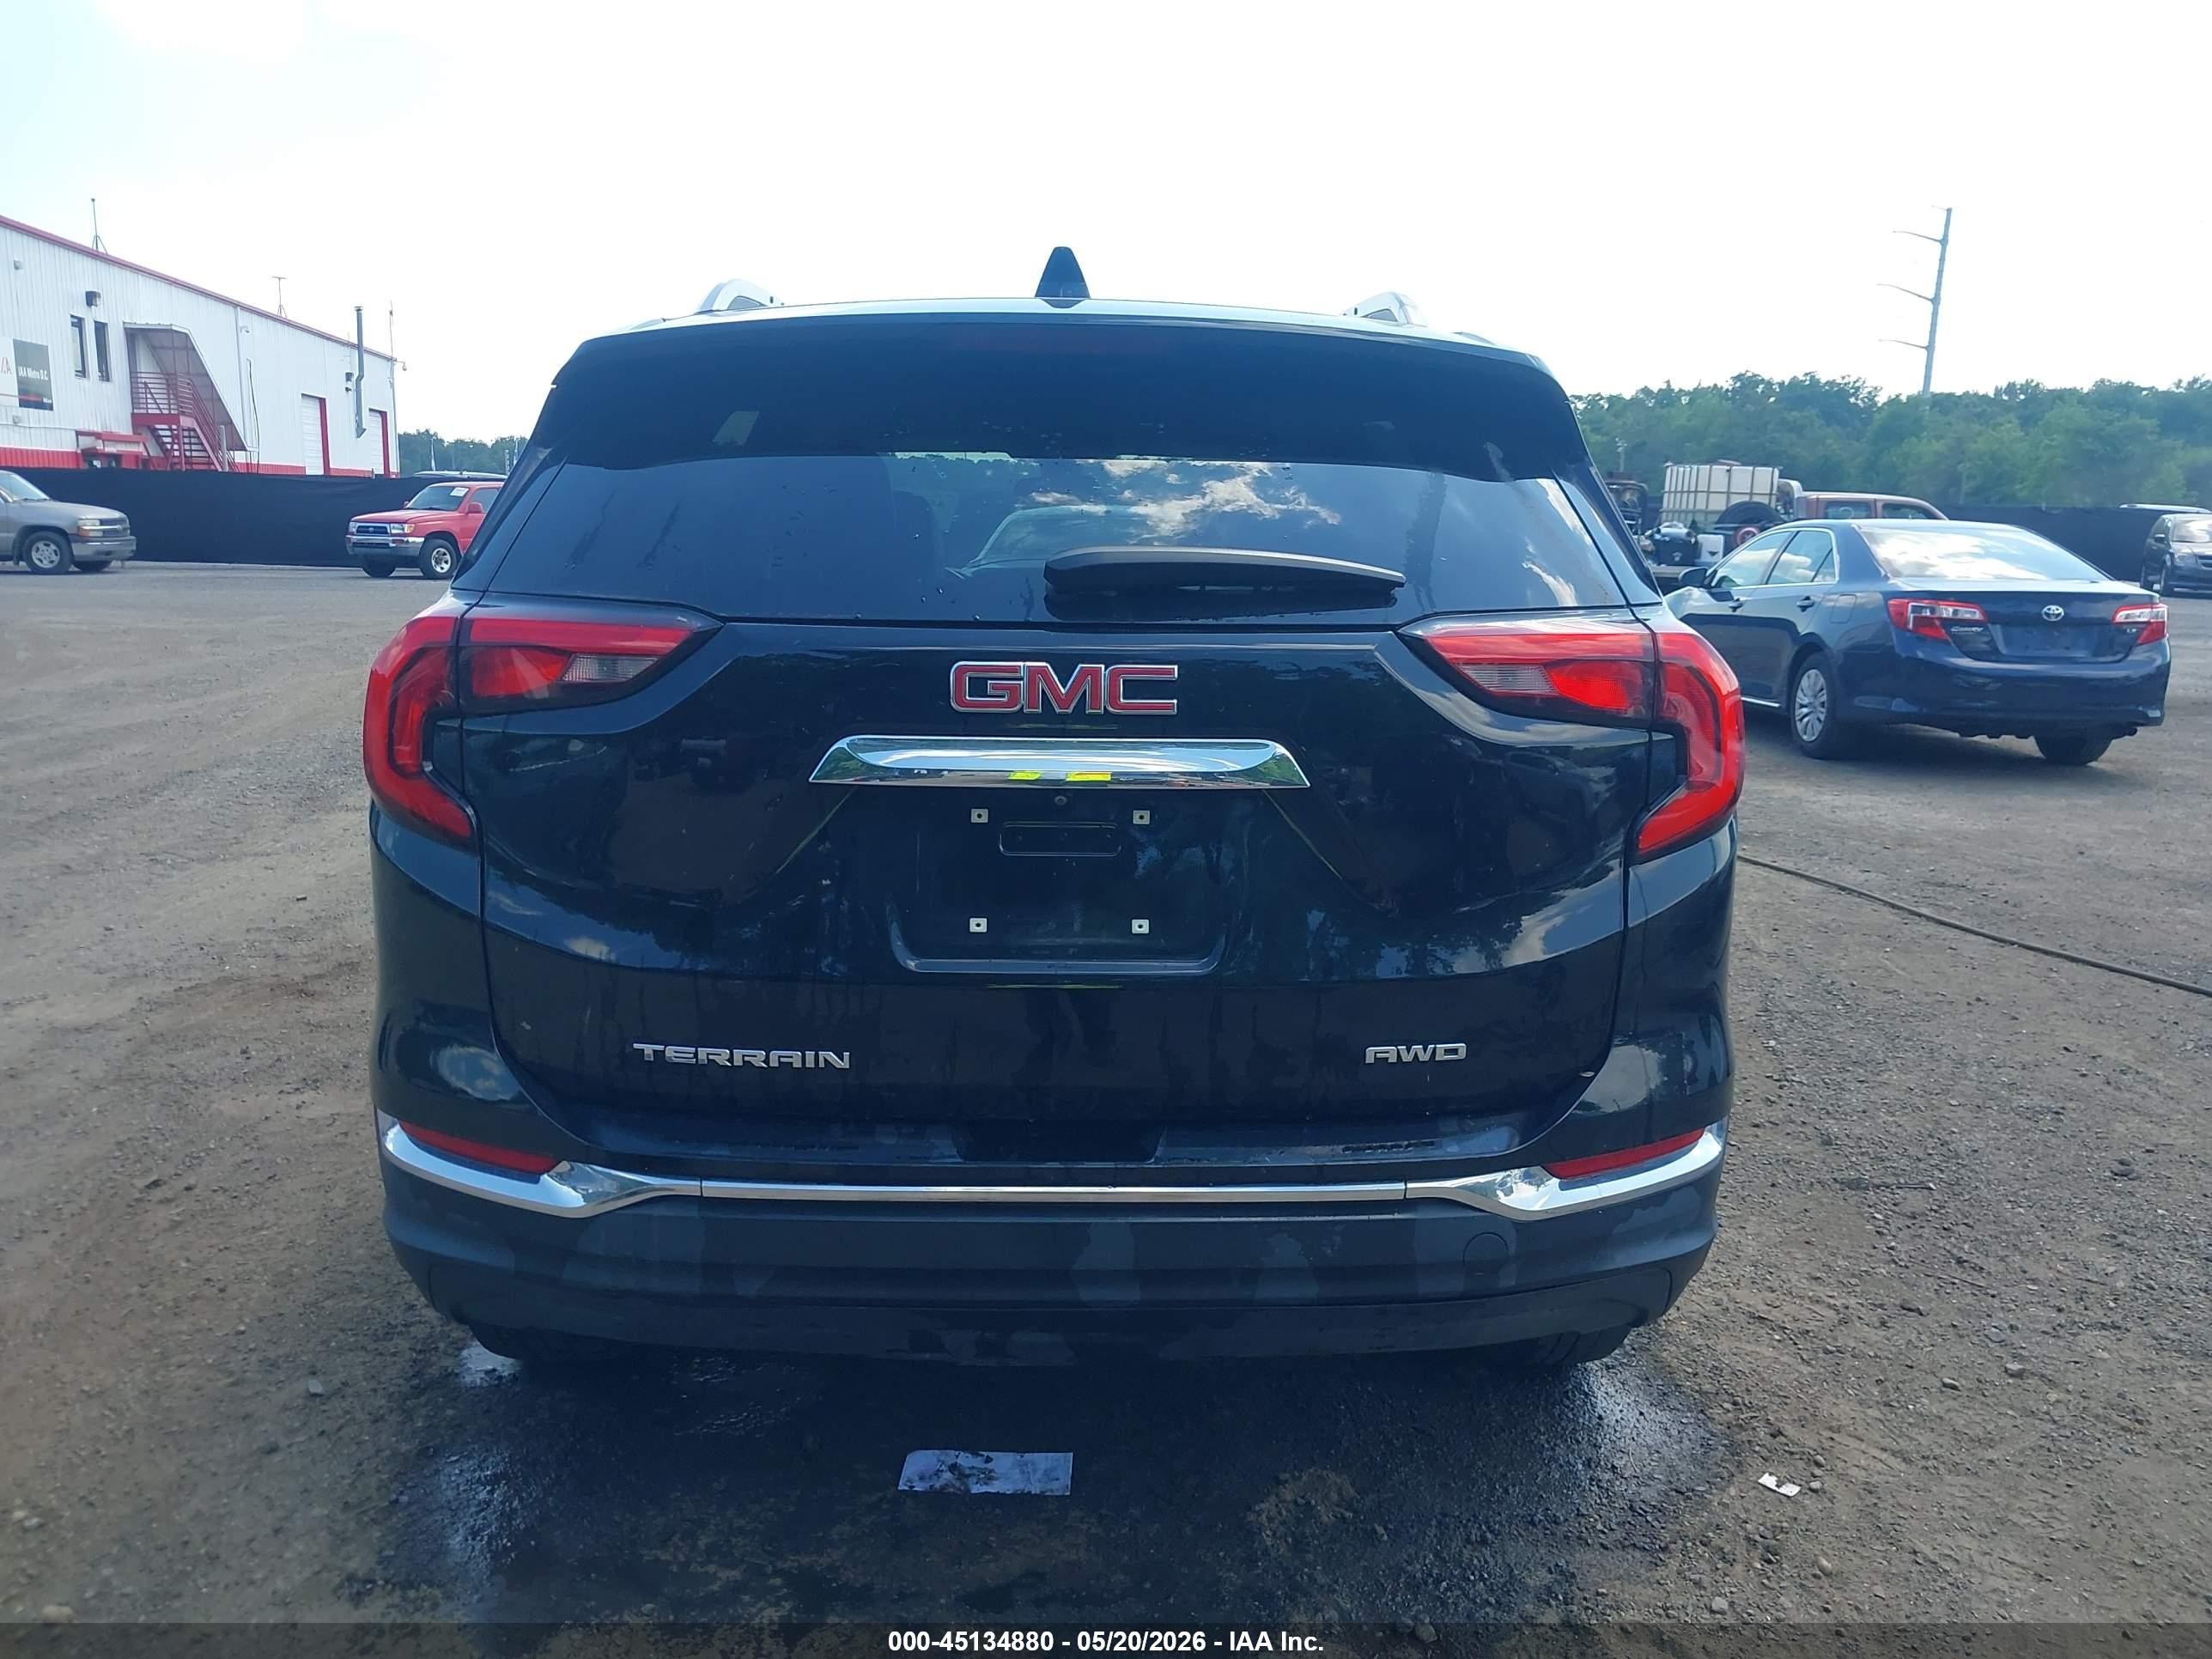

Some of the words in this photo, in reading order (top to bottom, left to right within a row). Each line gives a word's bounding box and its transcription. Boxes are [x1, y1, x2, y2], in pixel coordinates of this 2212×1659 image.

[950, 660, 1178, 714] GMC
[633, 1043, 851, 1069] TERRAIN
[1365, 1043, 1467, 1063] AWD
